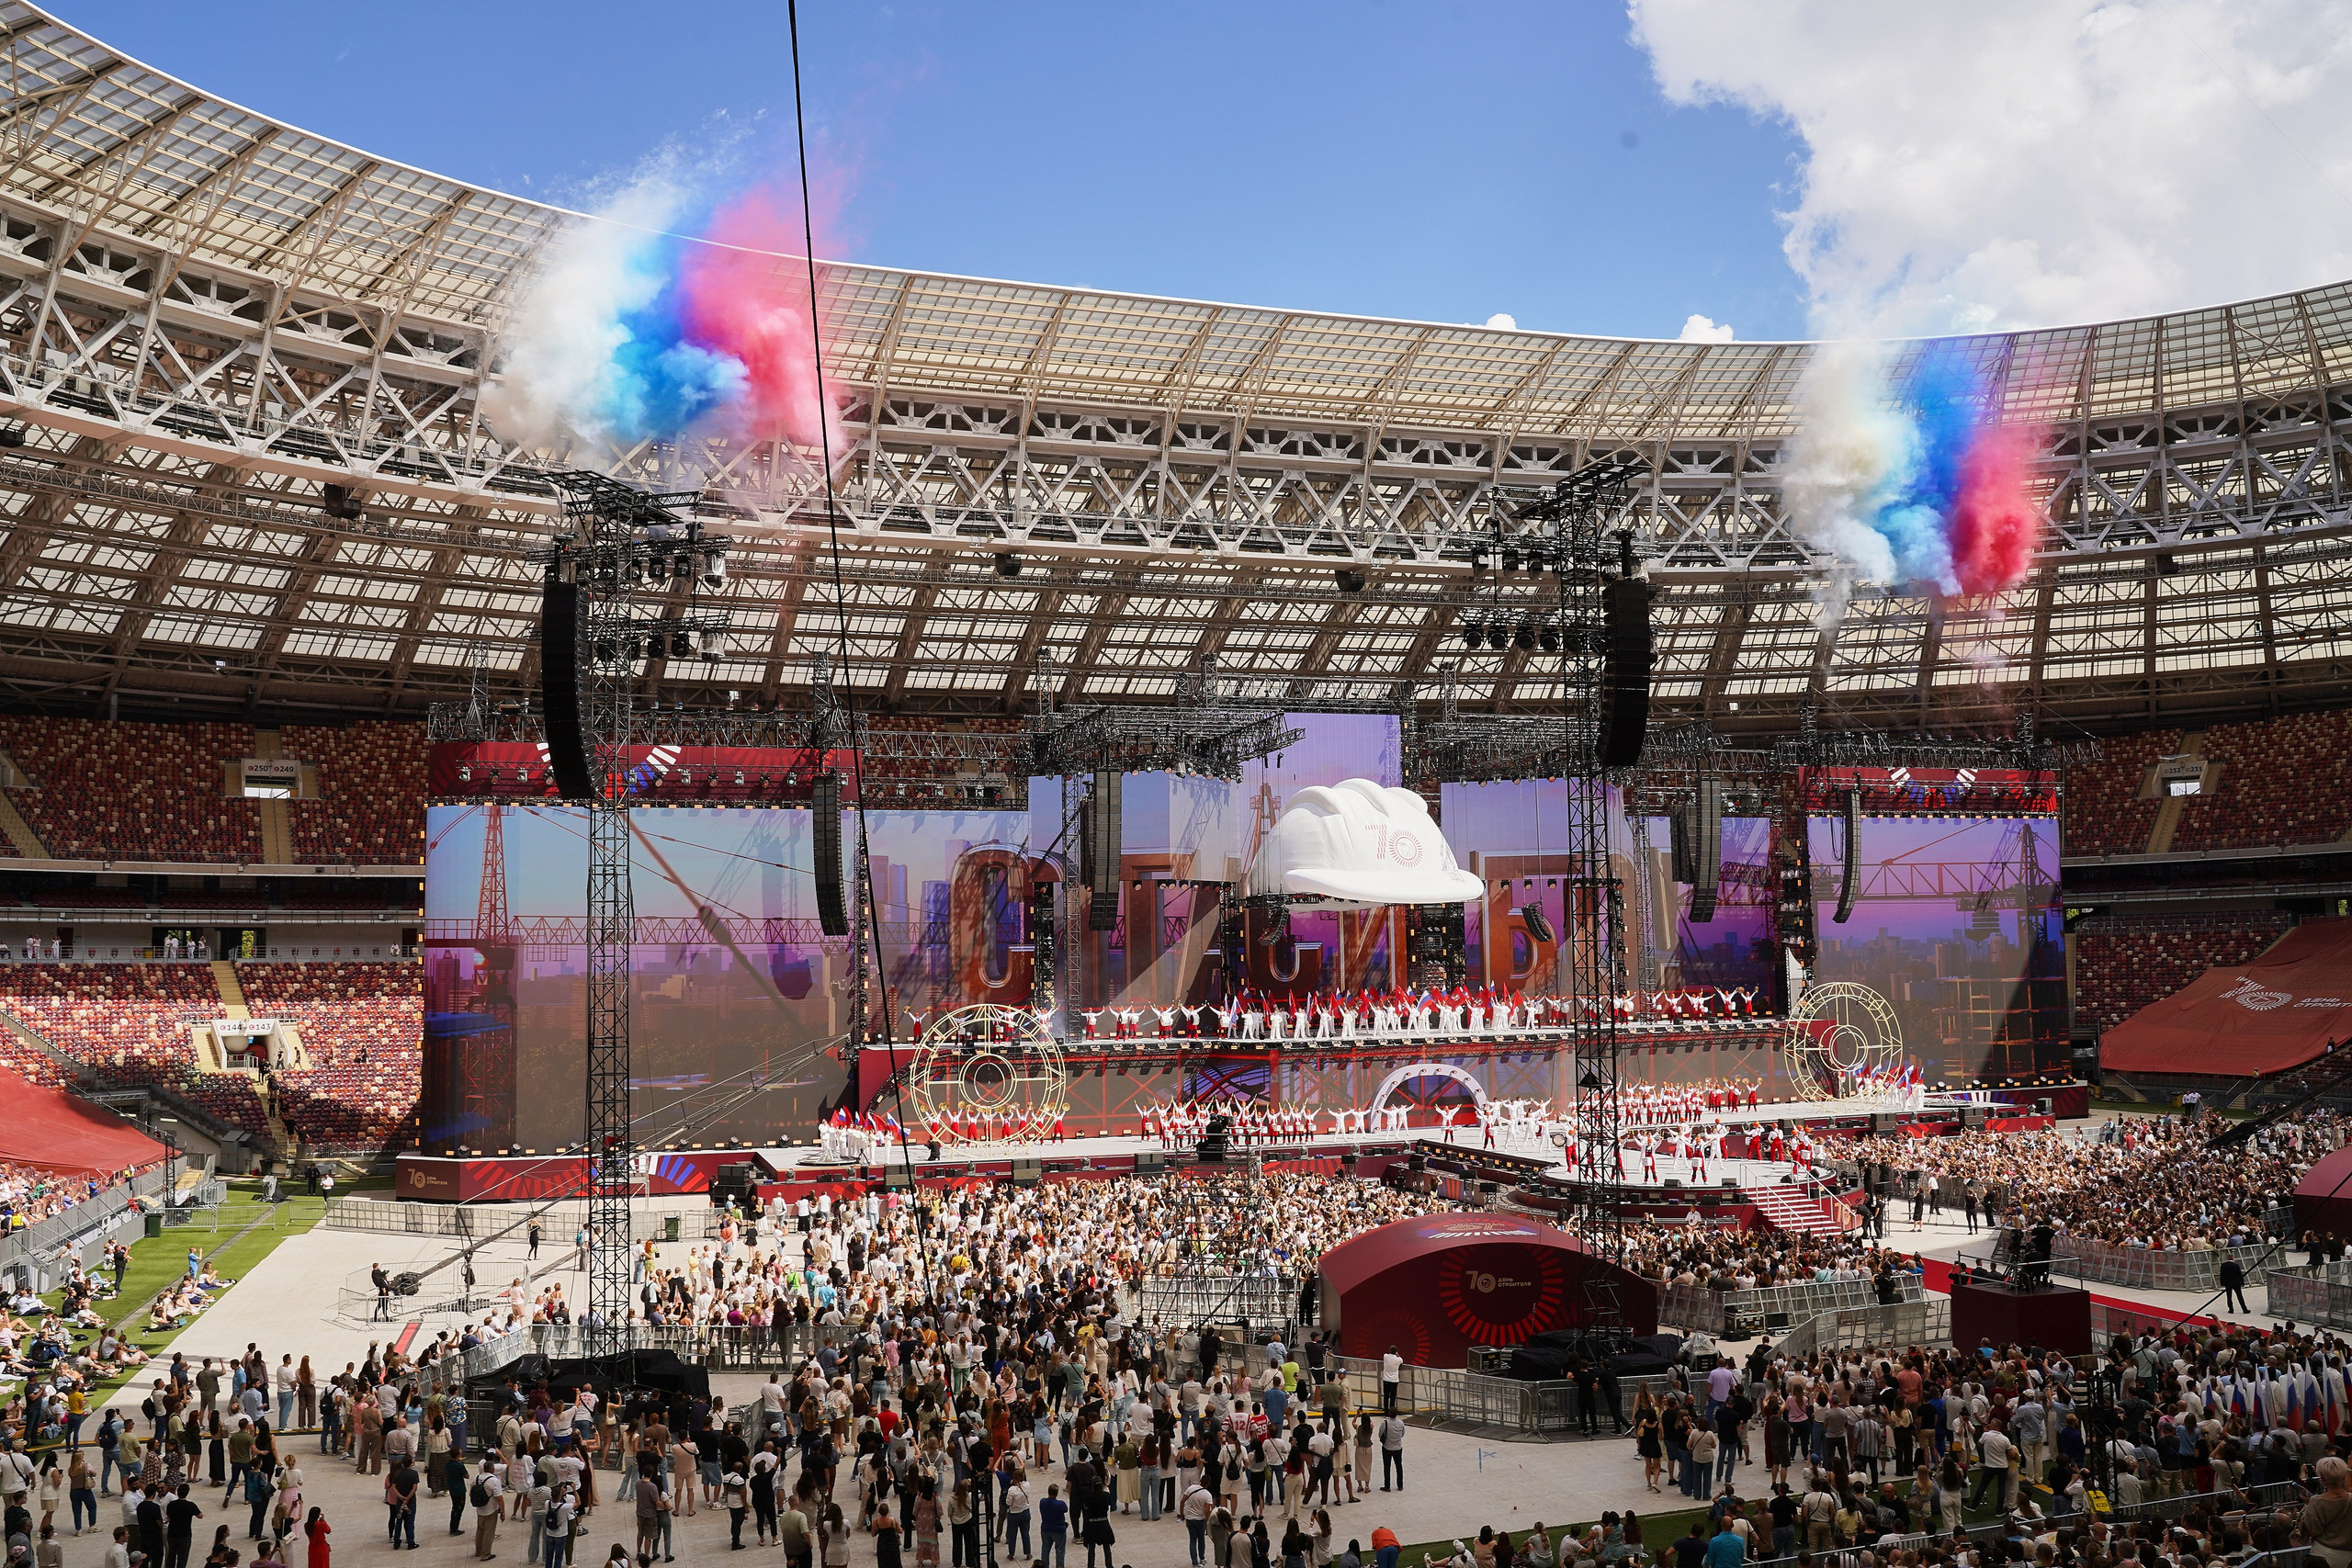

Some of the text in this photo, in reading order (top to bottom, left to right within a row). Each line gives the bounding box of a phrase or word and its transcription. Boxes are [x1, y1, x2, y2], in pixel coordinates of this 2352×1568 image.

[1364, 824, 1423, 868] 70
[2218, 976, 2293, 1010] 70
[407, 1168, 425, 1188] 70
[1466, 1270, 1496, 1293] 70
[1235, 1420, 1246, 1430] 12
